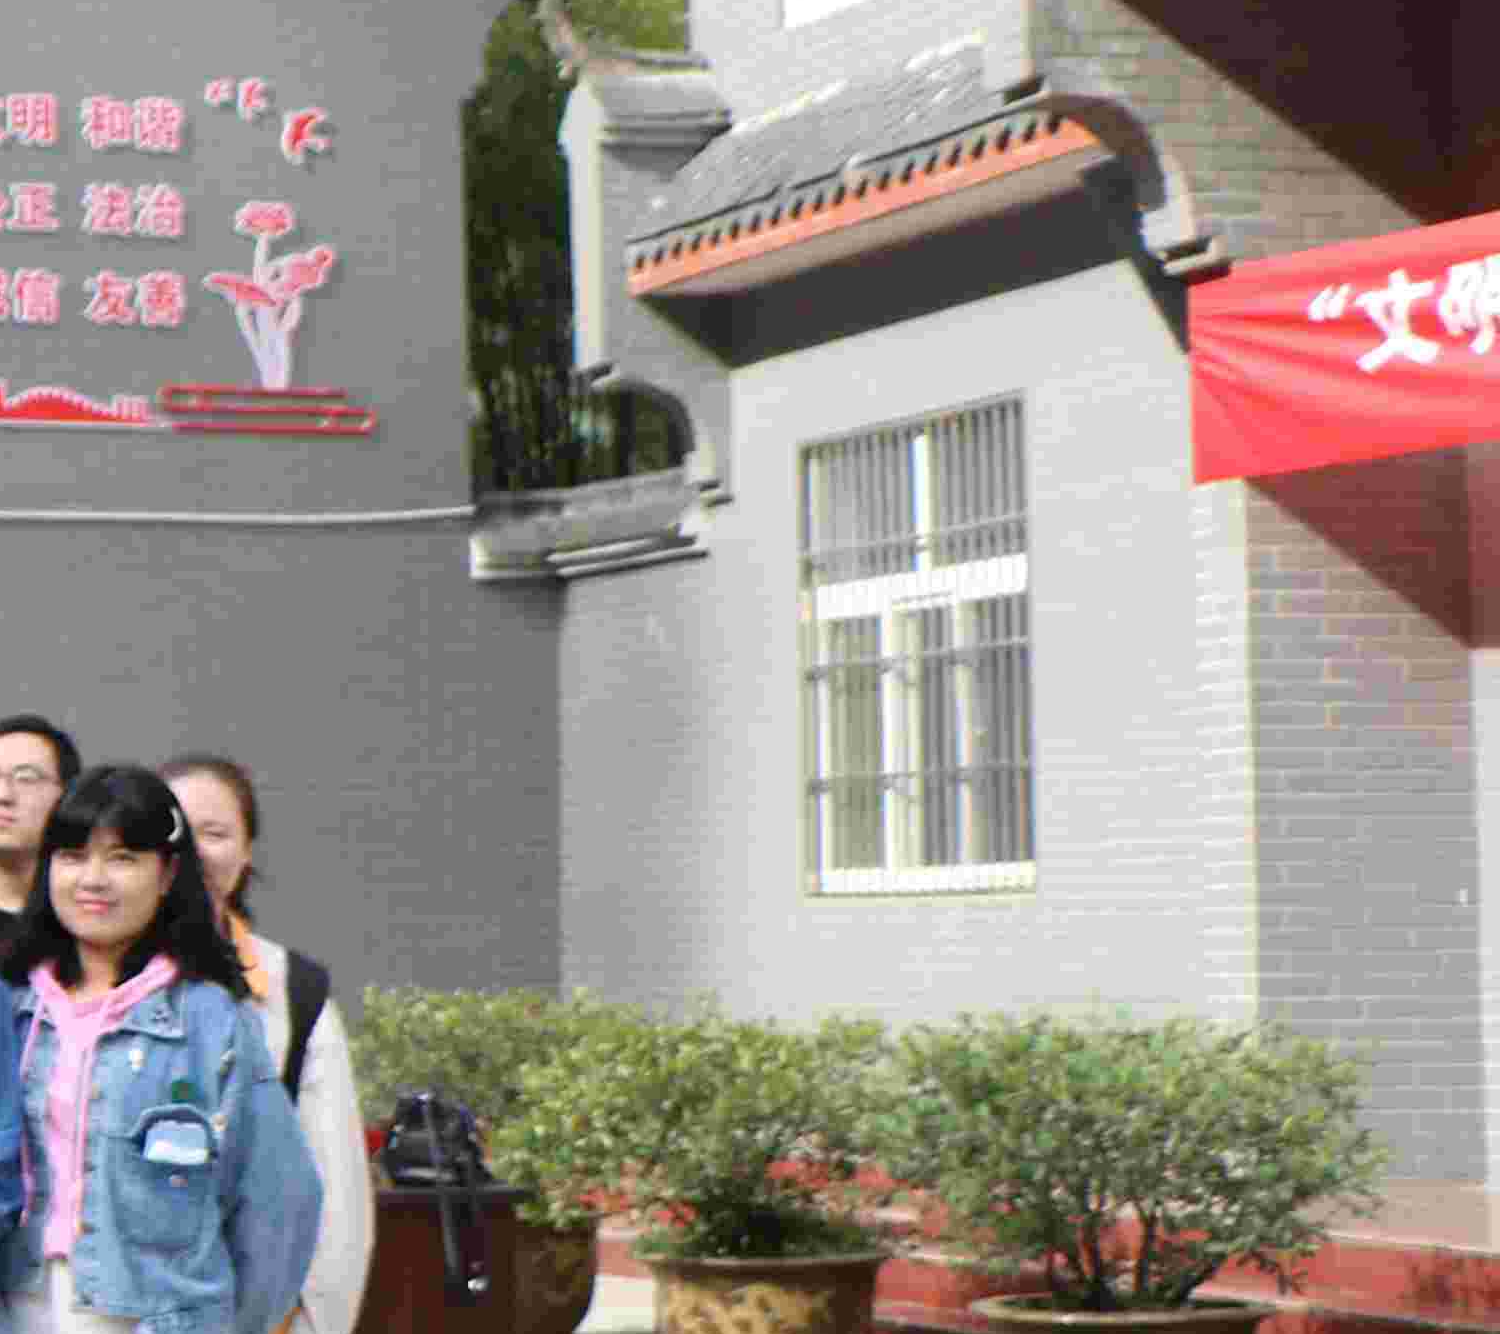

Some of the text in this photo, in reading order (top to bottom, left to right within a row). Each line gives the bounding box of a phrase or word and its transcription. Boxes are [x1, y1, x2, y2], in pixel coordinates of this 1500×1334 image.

[81, 95, 186, 153] 和谐
[80, 181, 184, 237] 法治
[83, 268, 188, 327] 友善
